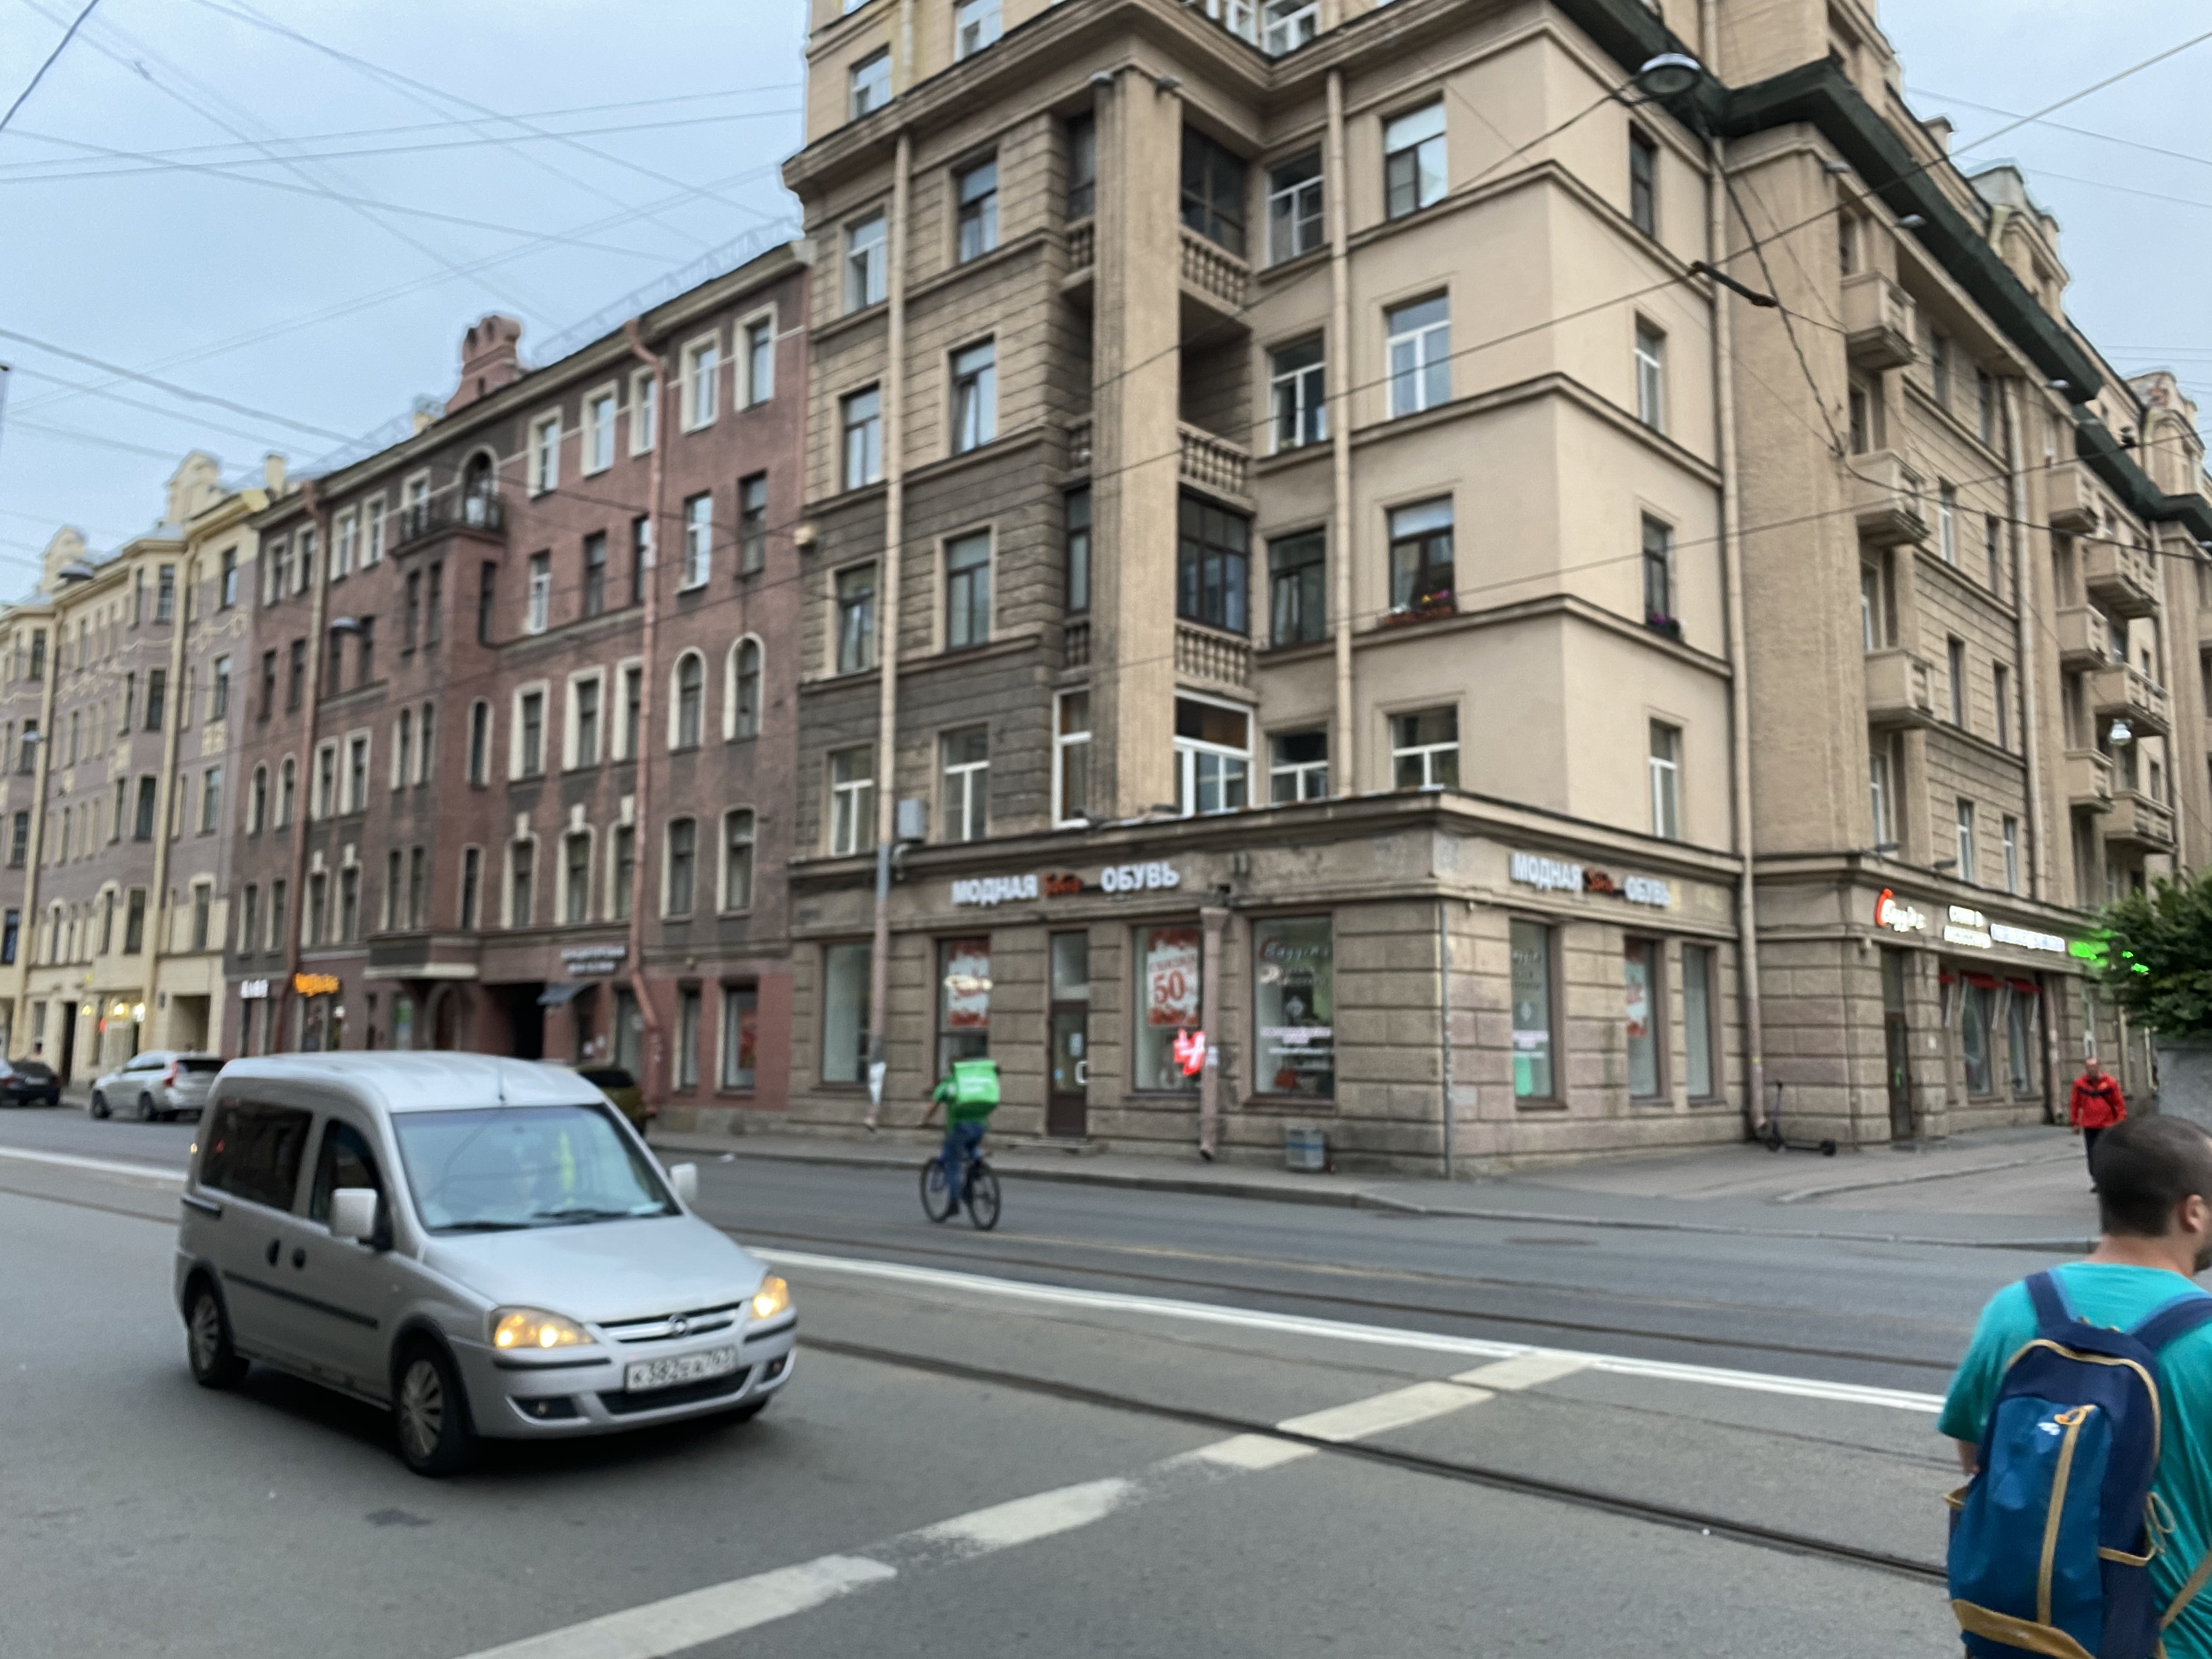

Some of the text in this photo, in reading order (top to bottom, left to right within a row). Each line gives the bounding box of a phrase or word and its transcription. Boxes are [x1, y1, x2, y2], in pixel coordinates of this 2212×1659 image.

[952, 874, 1037, 906] МОДНАЯ
[1101, 861, 1180, 892] ОБУВЬ
[1154, 970, 1185, 1005] 50
